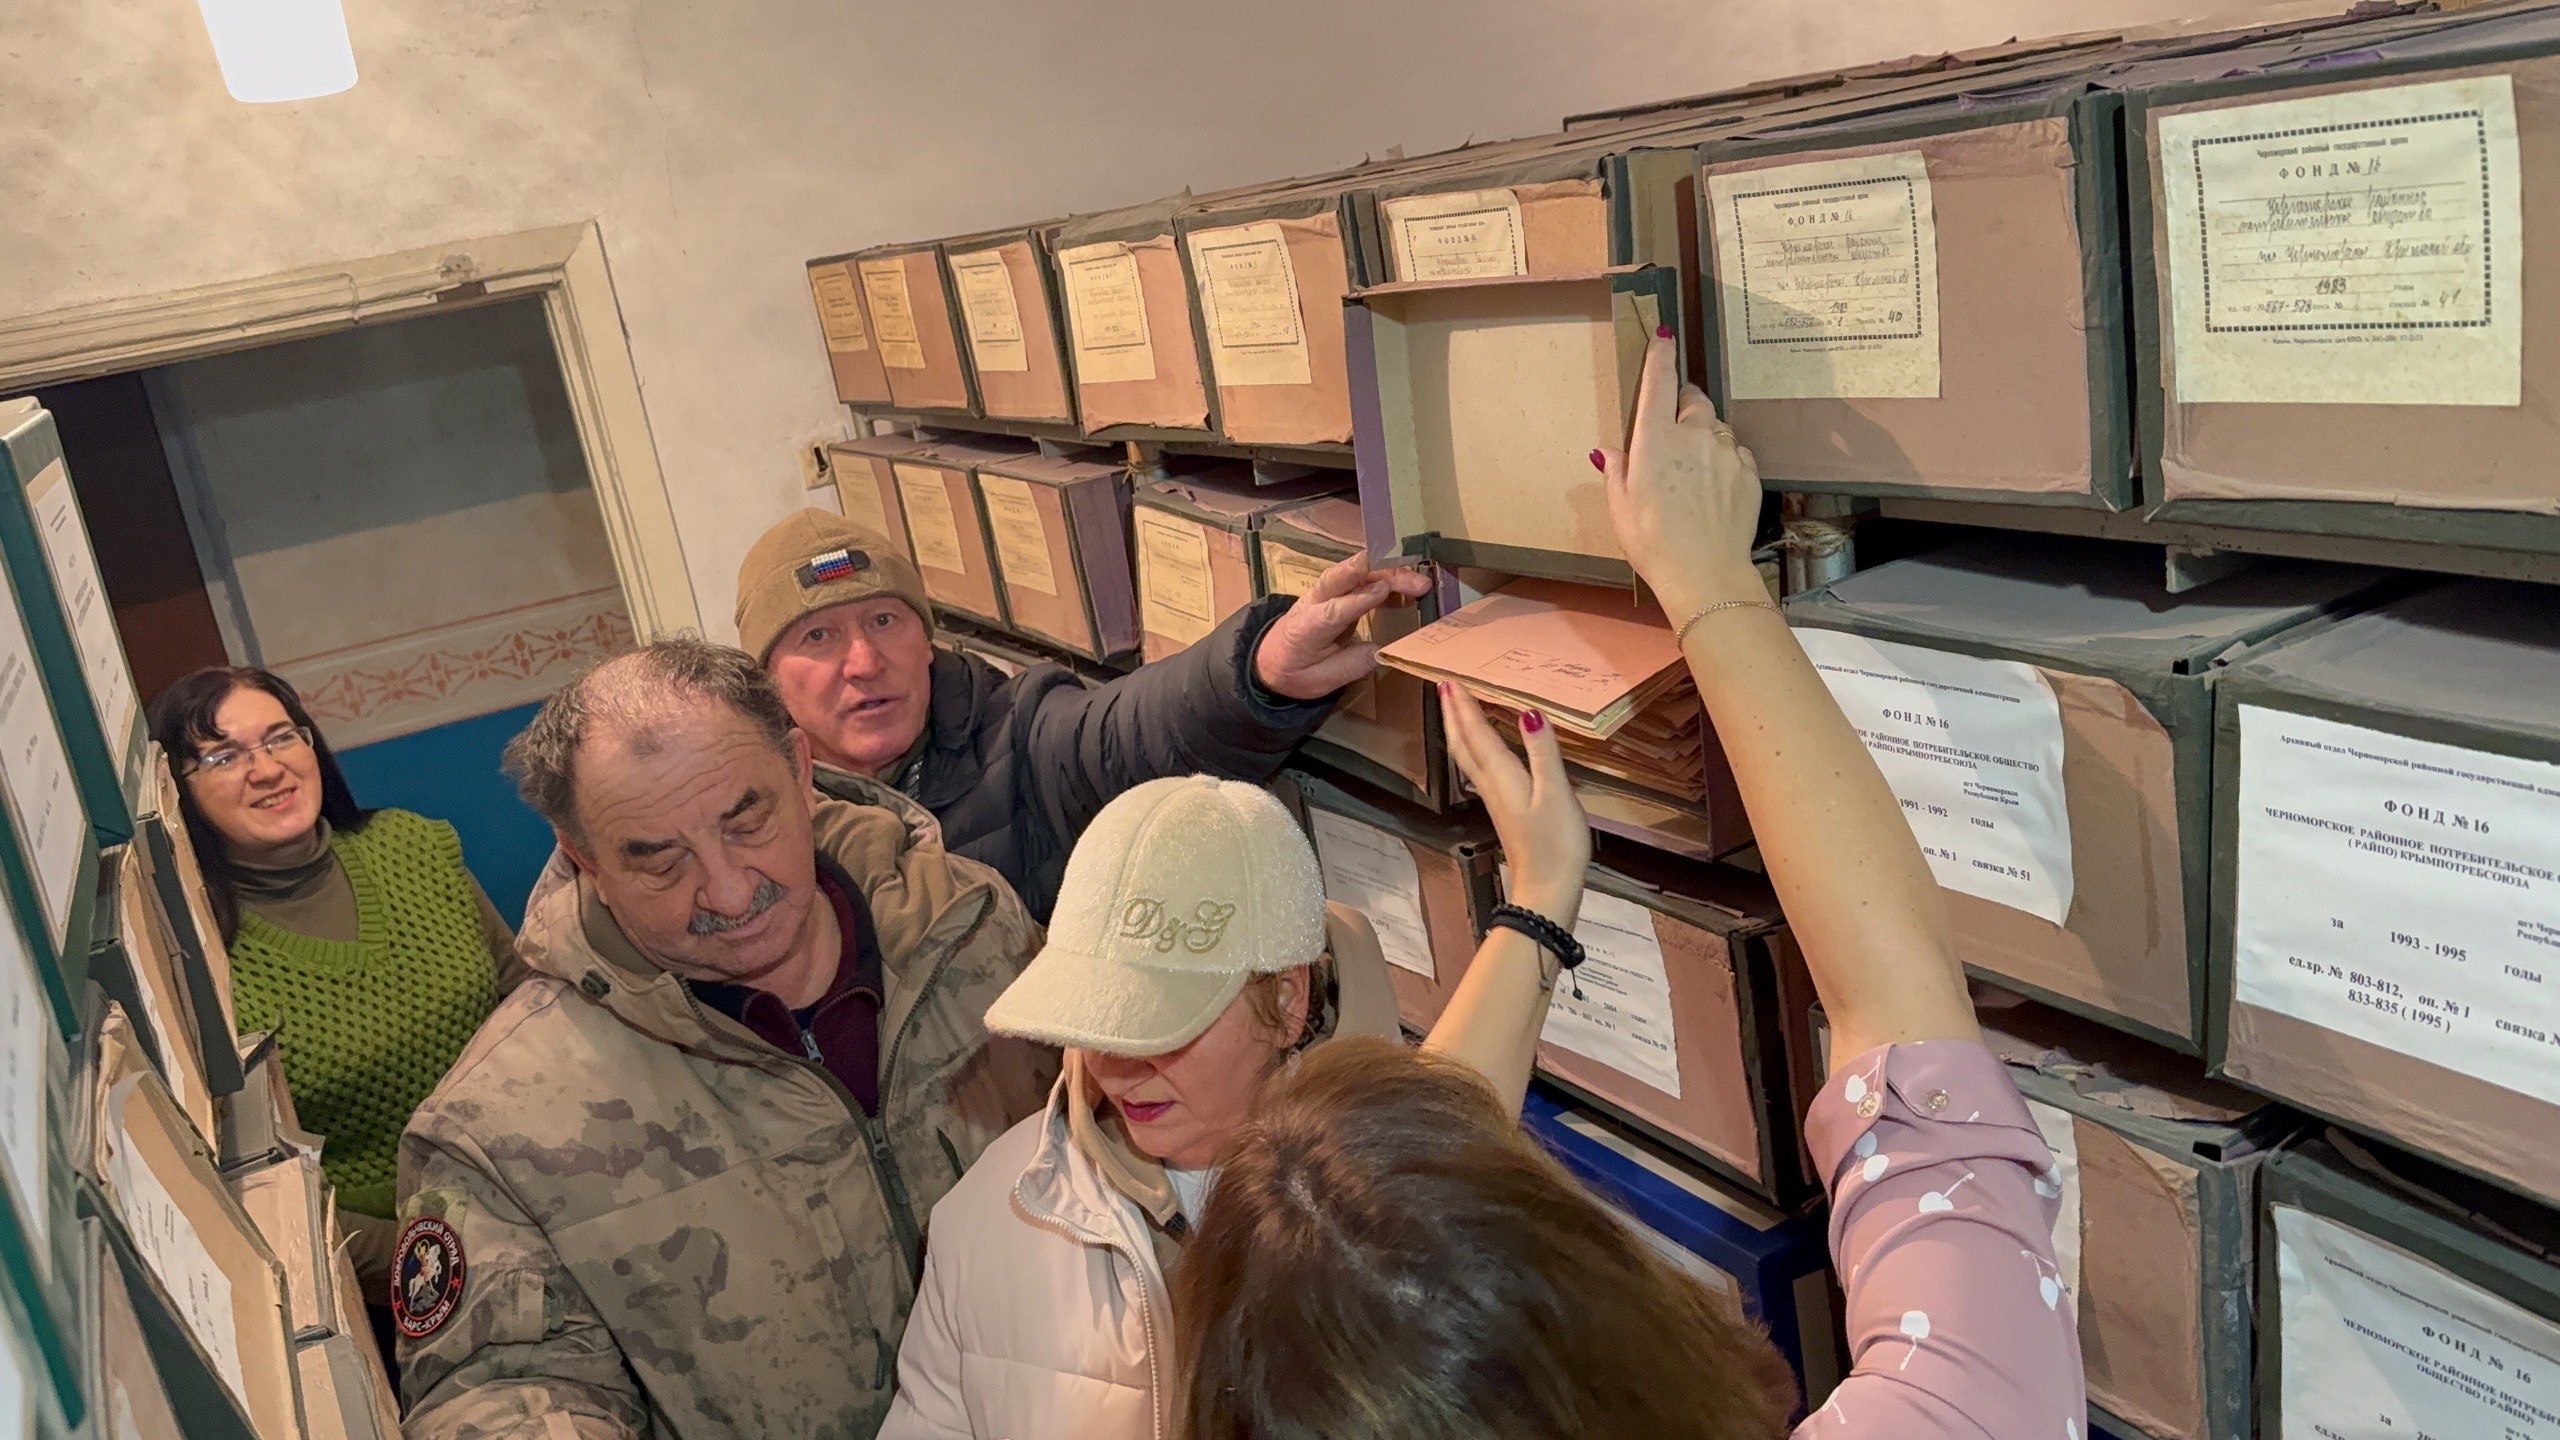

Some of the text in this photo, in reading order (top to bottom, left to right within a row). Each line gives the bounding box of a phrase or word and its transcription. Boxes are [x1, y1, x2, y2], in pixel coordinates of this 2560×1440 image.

[2279, 163, 2339, 179] ФОНД
[2346, 161, 2360, 174] №
[1787, 213, 1826, 225] ФОНД
[2315, 278, 2347, 296] 1983
[1882, 708, 1949, 730] ФОНД № 16
[1870, 732, 1910, 747] РАЙОННОЕ
[1913, 741, 1991, 763] ПОТРЕБИТЕЛЬСКОЕ
[1992, 755, 2040, 773] ОБЩЕСТВО
[1896, 747, 1977, 770] КРЫМПОТРЕБСОЮЗА
[2280, 734, 2322, 750] Архивный
[2323, 743, 2346, 755] отдел
[2348, 747, 2409, 768] Черноморской
[2411, 761, 2454, 777] районной
[2457, 769, 2534, 792] государственной
[1974, 782, 2019, 798] Черноморское
[1900, 798, 1919, 812] 1991
[1927, 804, 1948, 818] 1992
[1971, 817, 1995, 830] годы
[2384, 800, 2490, 834] ФОНД № 16
[2265, 807, 2554, 881] ЧЕРНОМОРСКОЕ РАЙОННОЕ ПОТРЕБИТЕЛЬСКОЕ
[1924, 845, 2031, 882] оп. № 1 связка № 51
[2400, 849, 2530, 890] КРЫМПОТРЕБСОЮЗА
[2330, 917, 2345, 930] за
[2390, 931, 2420, 951] 1993
[2434, 943, 2467, 963] 1995
[2504, 964, 2542, 983] годы
[2327, 964, 2343, 980] №
[2349, 971, 2404, 1000] 803-812,
[2418, 993, 2439, 1010] оп.
[2442, 999, 2460, 1016] №
[2463, 1004, 2471, 1019] 1
[2495, 1018, 2546, 1042] связка
[2348, 989, 2398, 1015] 833-835
[2343, 1317, 2431, 1364] ЧЕРНОМОРСКОЕ
[2434, 1359, 2497, 1396] РАЙОННОЕ
[2422, 1325, 2482, 1362] ФОНД
[2488, 1354, 2504, 1371] №
[2516, 1368, 2531, 1384] 16
[2416, 1363, 2481, 1399] ОБЩЕСТВО
[2380, 1413, 2392, 1426] за
